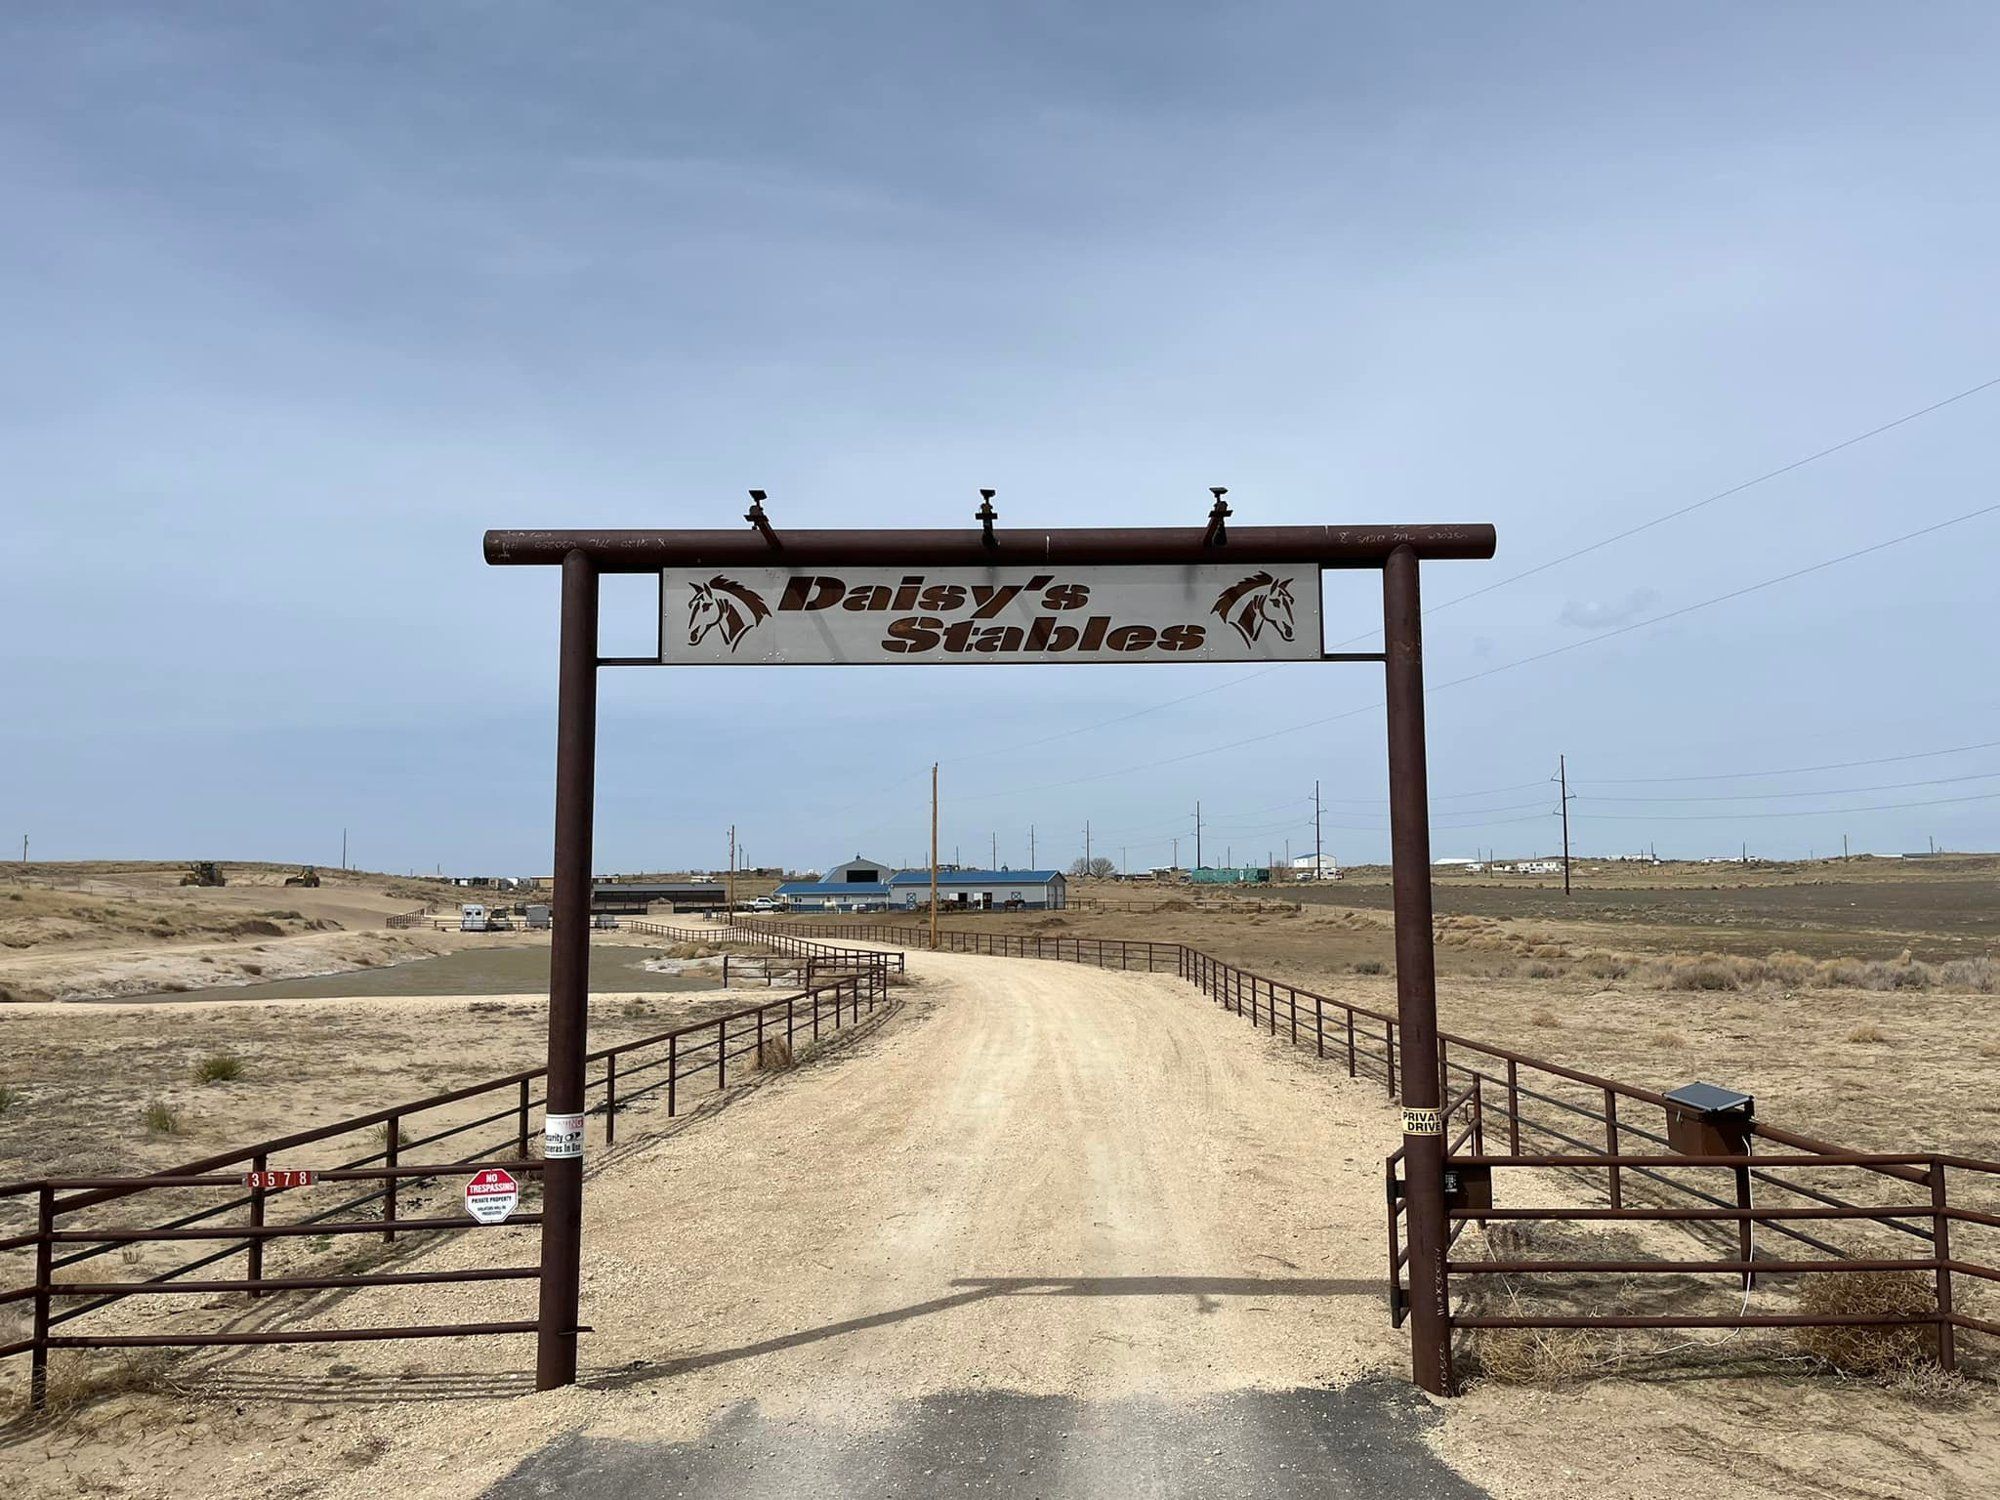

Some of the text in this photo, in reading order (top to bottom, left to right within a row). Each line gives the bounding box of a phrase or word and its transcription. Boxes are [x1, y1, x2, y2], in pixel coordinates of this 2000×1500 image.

[778, 575, 1091, 618] Daisy's
[881, 617, 1206, 654] Stables
[1403, 1111, 1441, 1122] PRIVAT
[1408, 1122, 1440, 1131] DRIVE
[486, 1173, 498, 1183] NO
[469, 1182, 514, 1194] TRESPASSING
